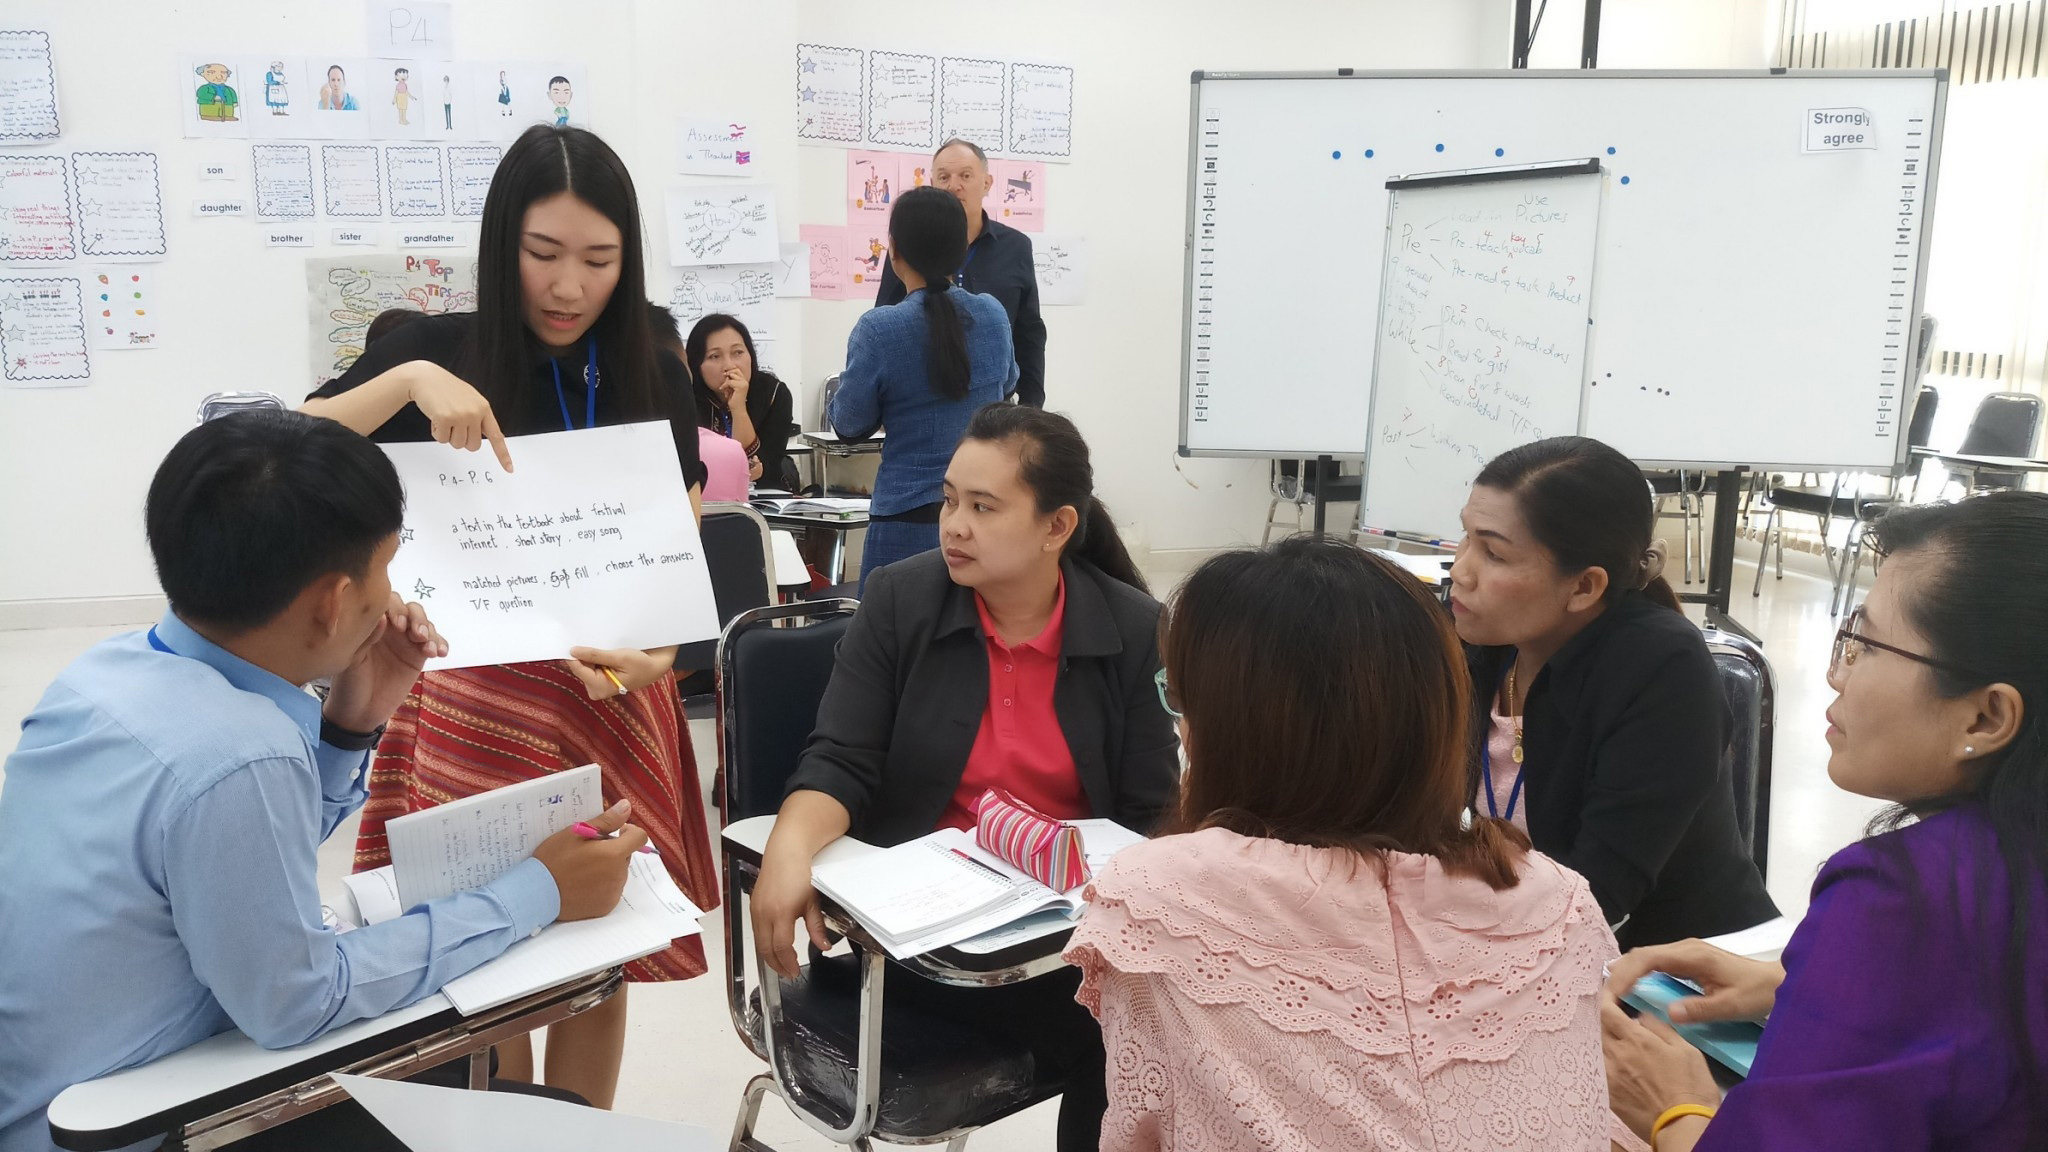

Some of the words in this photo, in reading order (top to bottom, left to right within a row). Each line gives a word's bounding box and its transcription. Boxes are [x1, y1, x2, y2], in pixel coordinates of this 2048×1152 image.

[388, 8, 434, 46] P4
[1814, 112, 1870, 126] Strongly
[1823, 134, 1865, 147] agree
[206, 167, 224, 175] son
[200, 204, 242, 214] daughter
[270, 234, 304, 243] brother
[339, 232, 362, 241] sister
[403, 234, 455, 244] grandfather
[422, 258, 454, 283] Top
[451, 524, 459, 533] a
[460, 517, 482, 532] text
[482, 520, 495, 532] in
[496, 514, 513, 529] the
[515, 513, 554, 530] textbook
[559, 507, 583, 524] about
[591, 502, 626, 516] festival
[577, 528, 596, 542] easy
[599, 527, 623, 541] song
[462, 574, 502, 590] matched
[506, 575, 539, 593] pictures
[574, 565, 590, 580] fill
[605, 560, 634, 573] choose
[637, 553, 655, 567] the
[660, 551, 694, 564] answers
[499, 595, 534, 613] question
